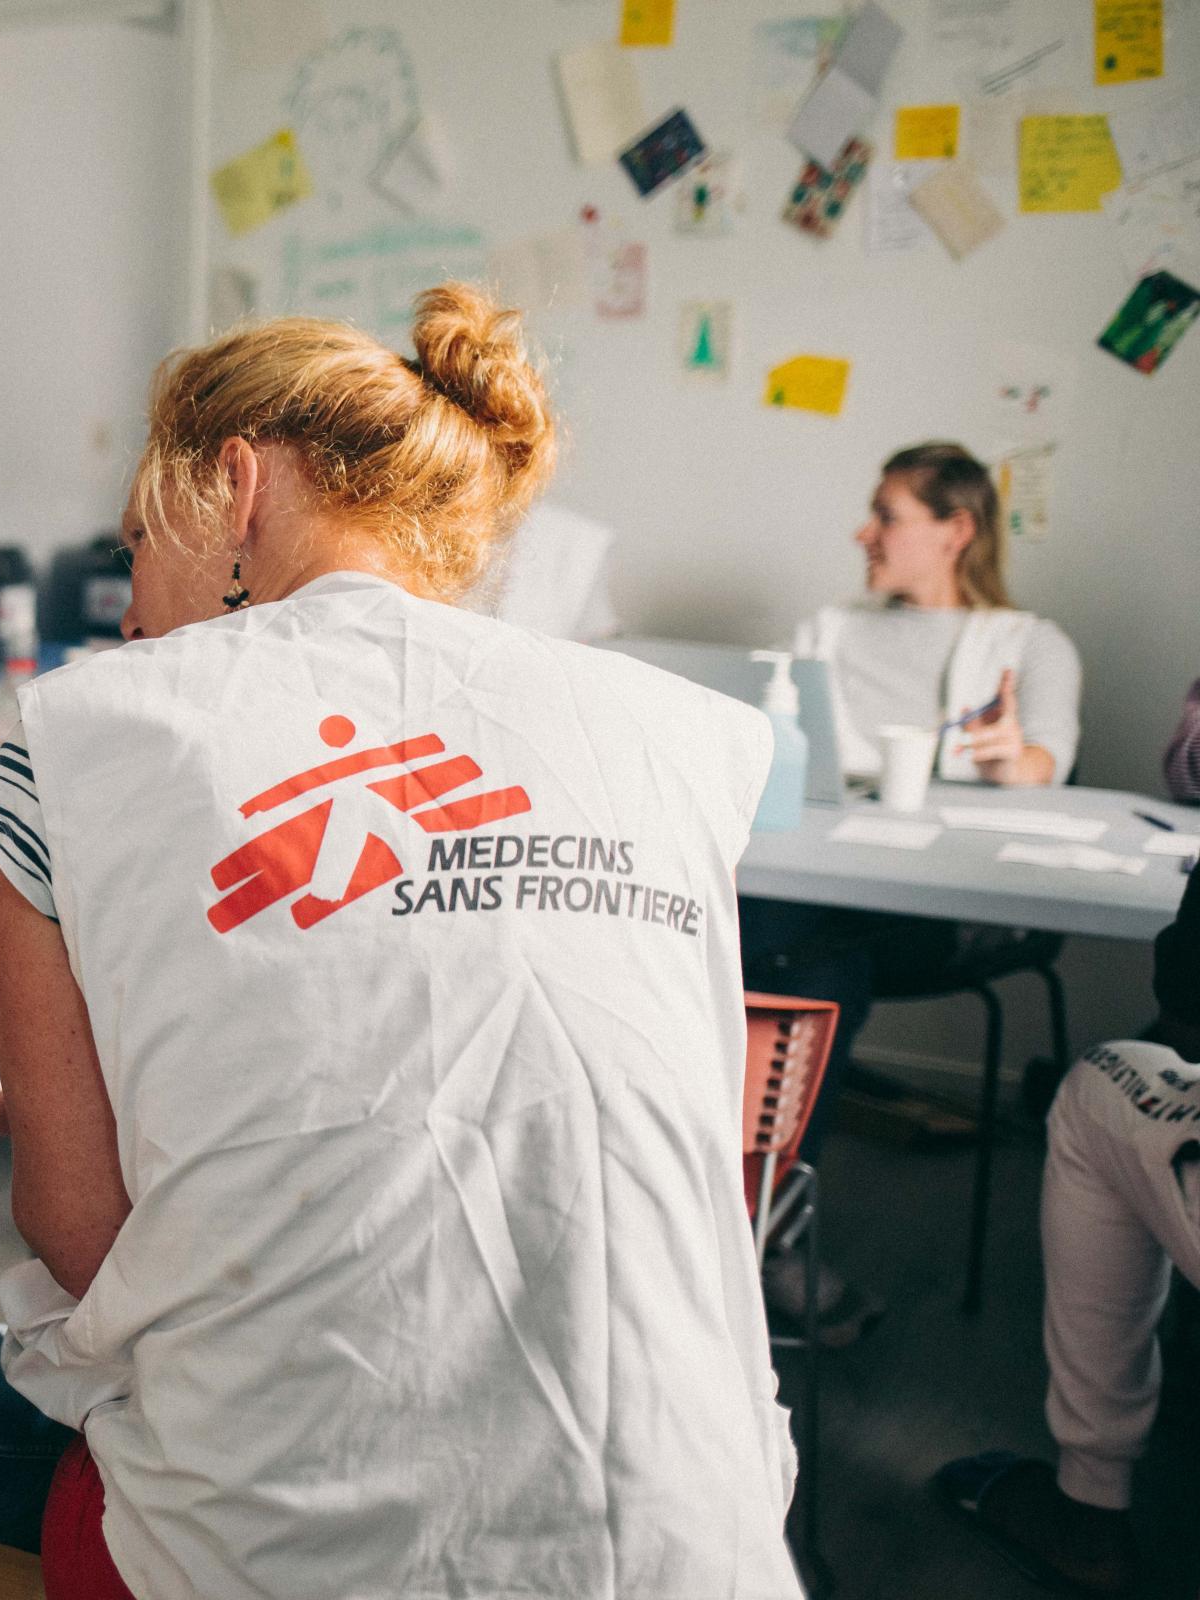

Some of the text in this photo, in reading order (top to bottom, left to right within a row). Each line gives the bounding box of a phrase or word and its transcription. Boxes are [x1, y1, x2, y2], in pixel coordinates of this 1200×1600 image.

[427, 835, 634, 876] MEDECINS
[391, 875, 703, 937] SANS FRONTIERE
